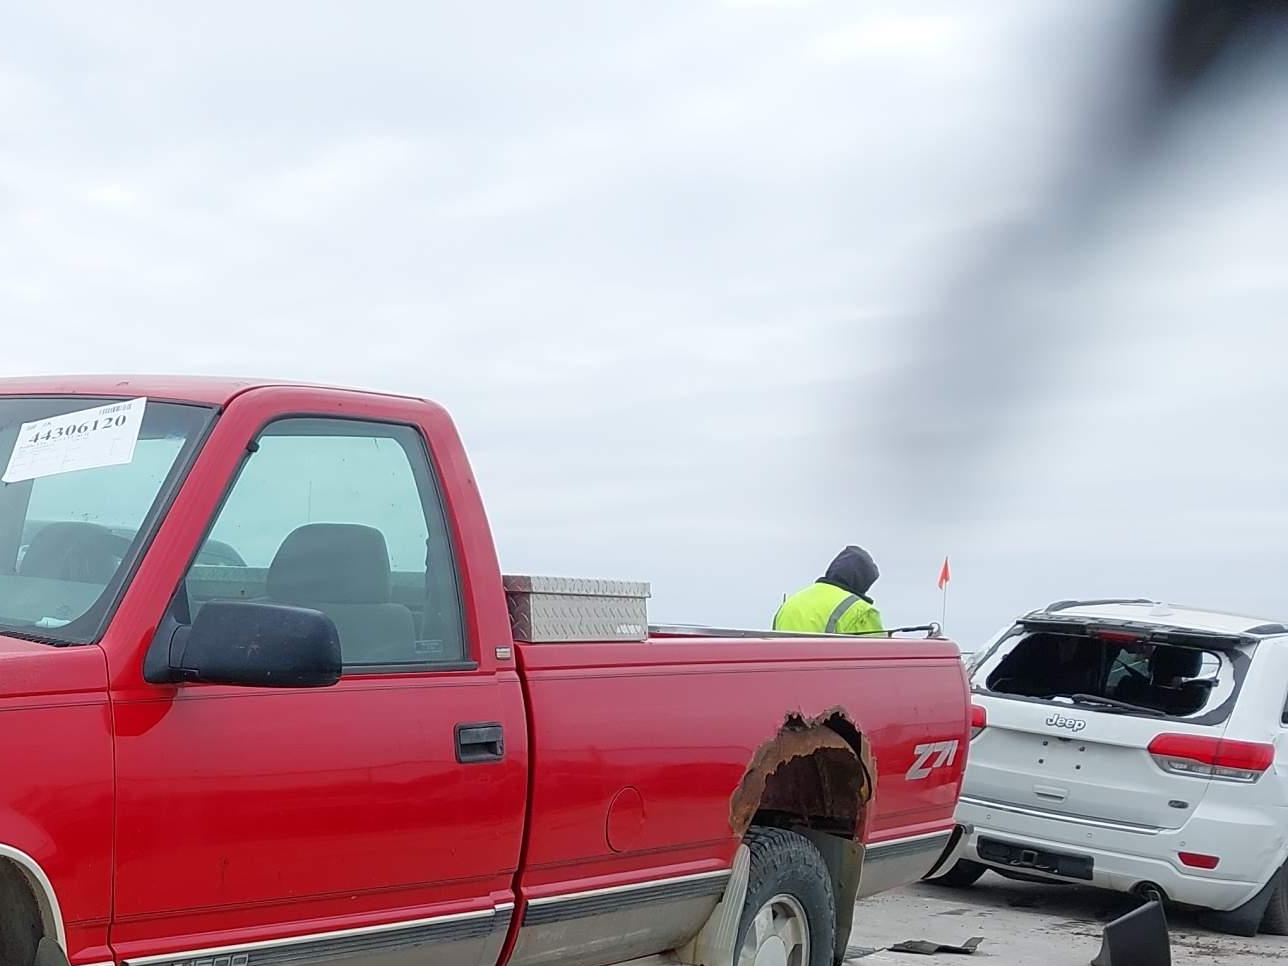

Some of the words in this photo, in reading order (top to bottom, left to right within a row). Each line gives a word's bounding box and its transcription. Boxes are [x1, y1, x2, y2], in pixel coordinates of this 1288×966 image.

[29, 415, 127, 444] 44306120
[1046, 713, 1086, 732] Jeep
[905, 740, 959, 780] Z71
